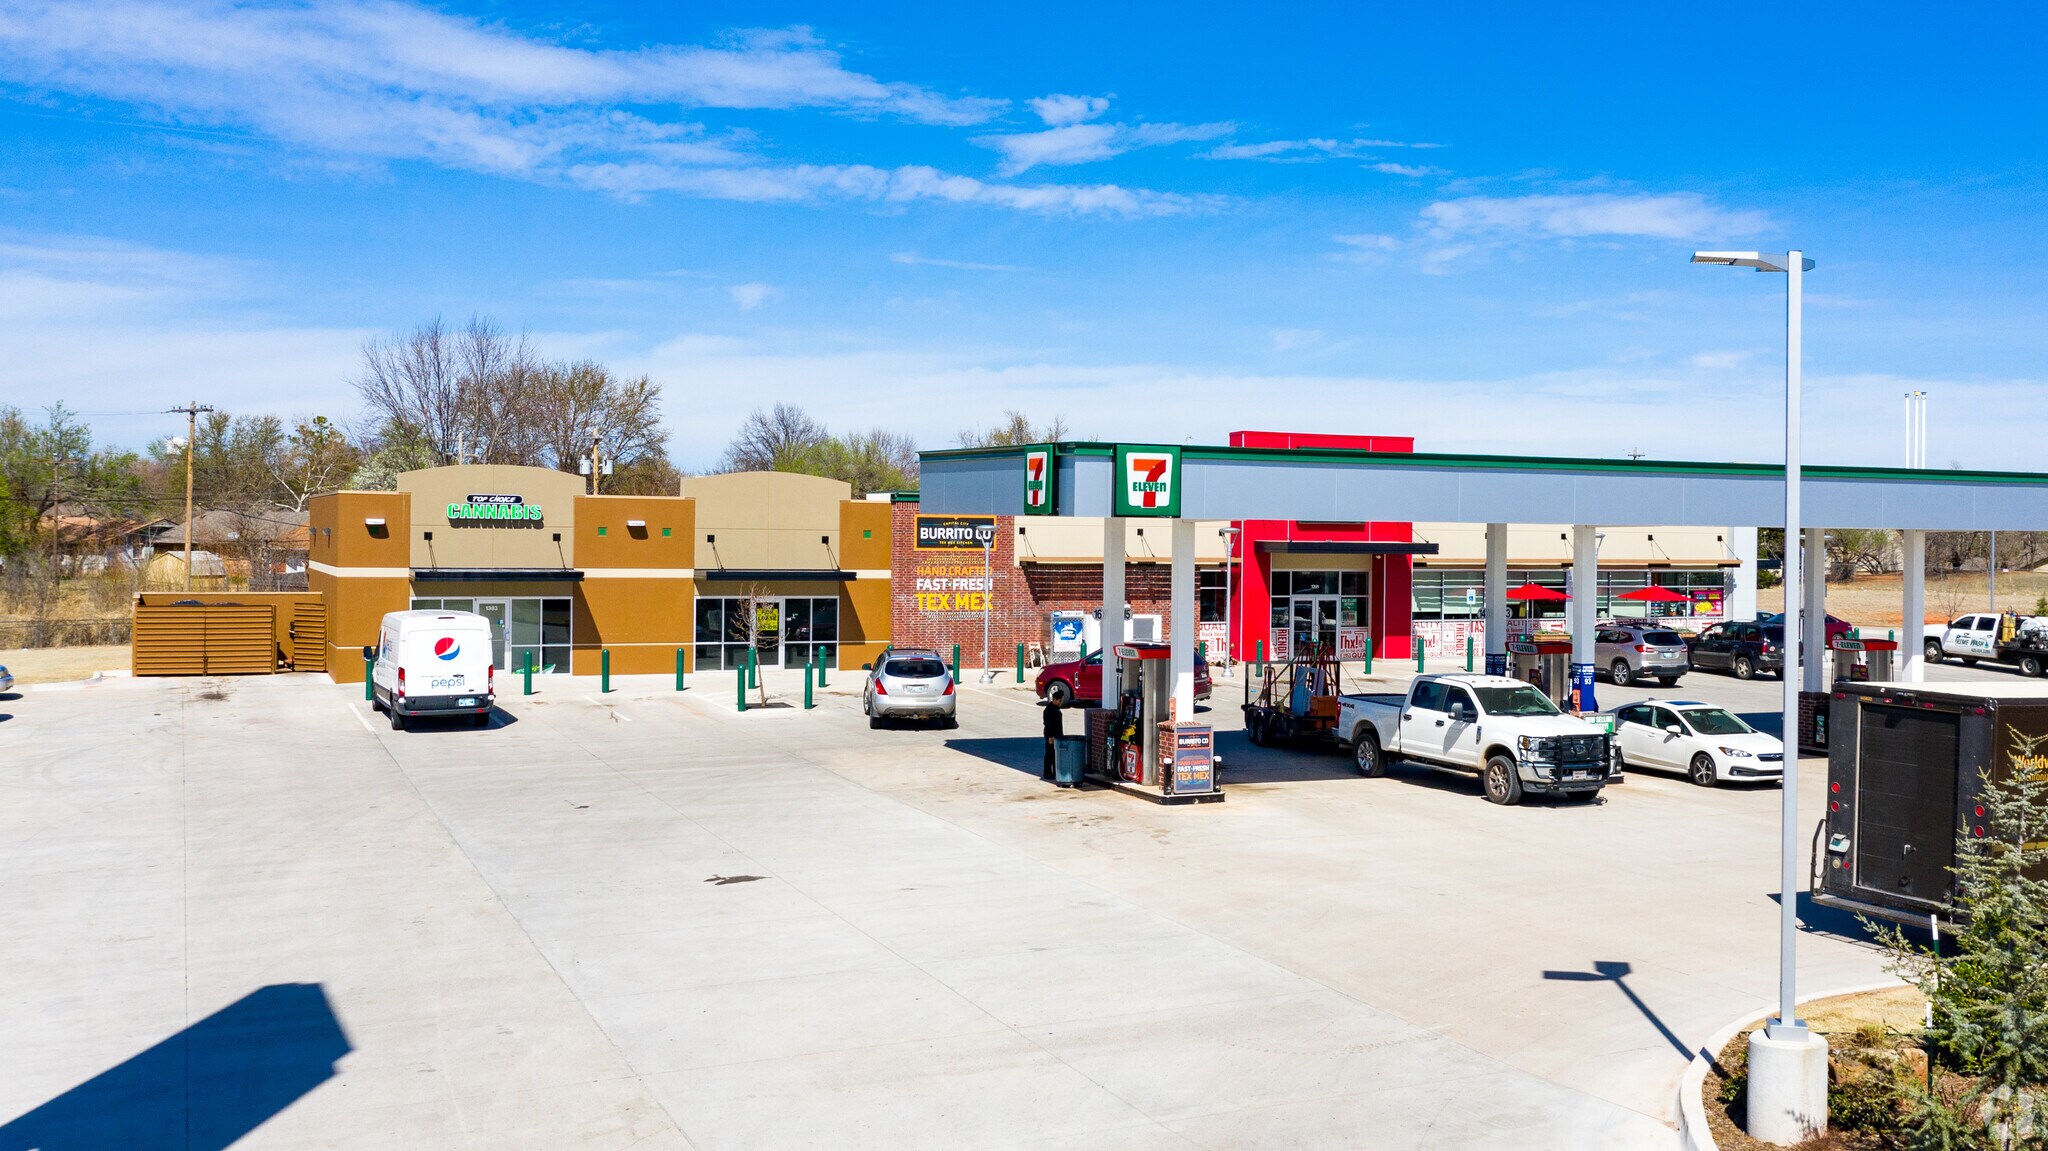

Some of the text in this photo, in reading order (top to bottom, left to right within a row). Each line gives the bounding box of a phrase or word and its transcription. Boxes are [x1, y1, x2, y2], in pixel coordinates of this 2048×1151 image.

[447, 503, 542, 520] CANNABIS
[920, 527, 973, 540] BURRITO
[917, 566, 946, 576] HAND
[915, 593, 994, 611] TEX MEX
[1094, 609, 1102, 619] 16
[1506, 608, 1511, 618] 3
[1455, 623, 1465, 656] FRIENDLY
[1955, 634, 1985, 647] PRIME WASH
[431, 676, 465, 689] pepsi
[1177, 772, 1192, 780] TEX
